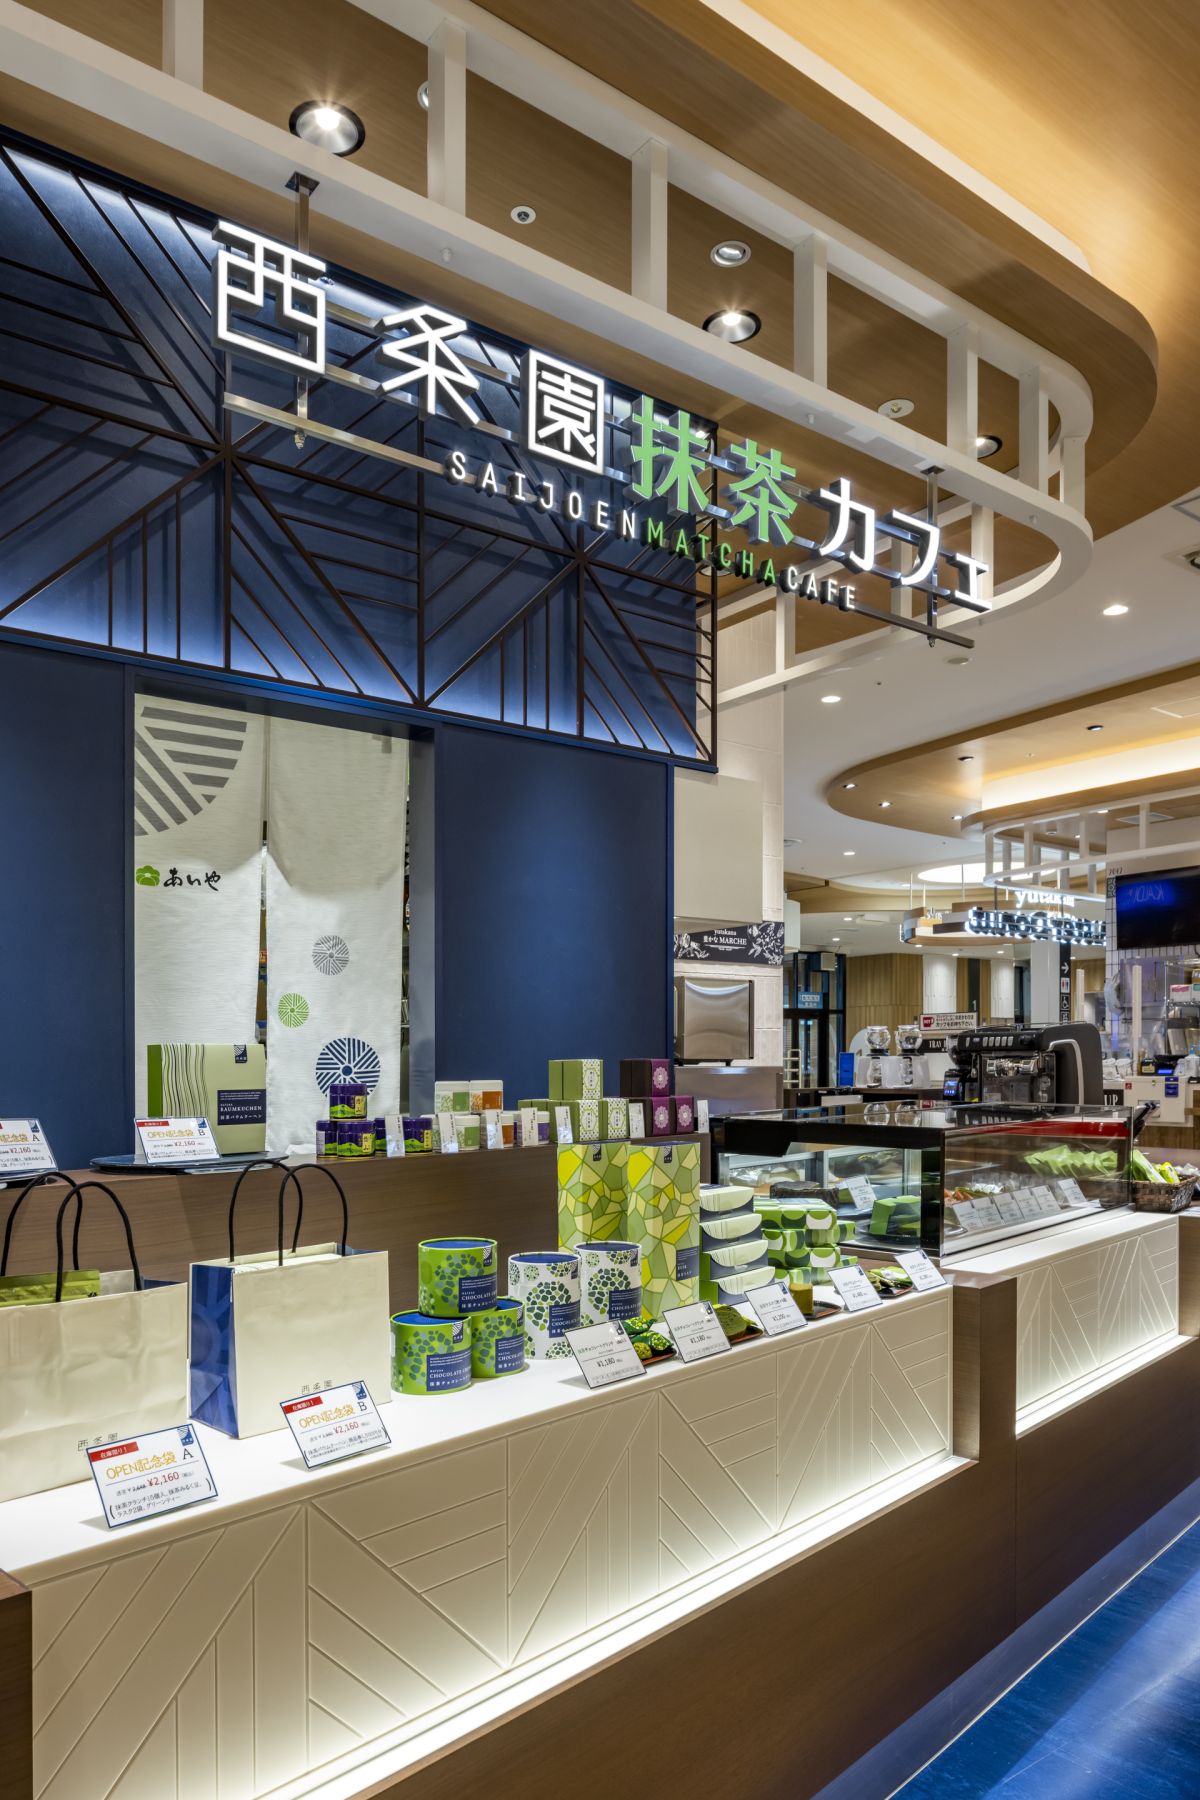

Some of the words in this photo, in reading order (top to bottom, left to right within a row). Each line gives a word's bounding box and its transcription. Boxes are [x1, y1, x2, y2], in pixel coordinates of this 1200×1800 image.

[163, 867, 221, 891] あいや
[357, 1401, 368, 1411] B
[333, 1421, 360, 1435] ¥2,160
[106, 1450, 177, 1480] OPEN記念袋
[182, 1448, 195, 1460] A
[147, 1471, 180, 1487] ¥2,160
